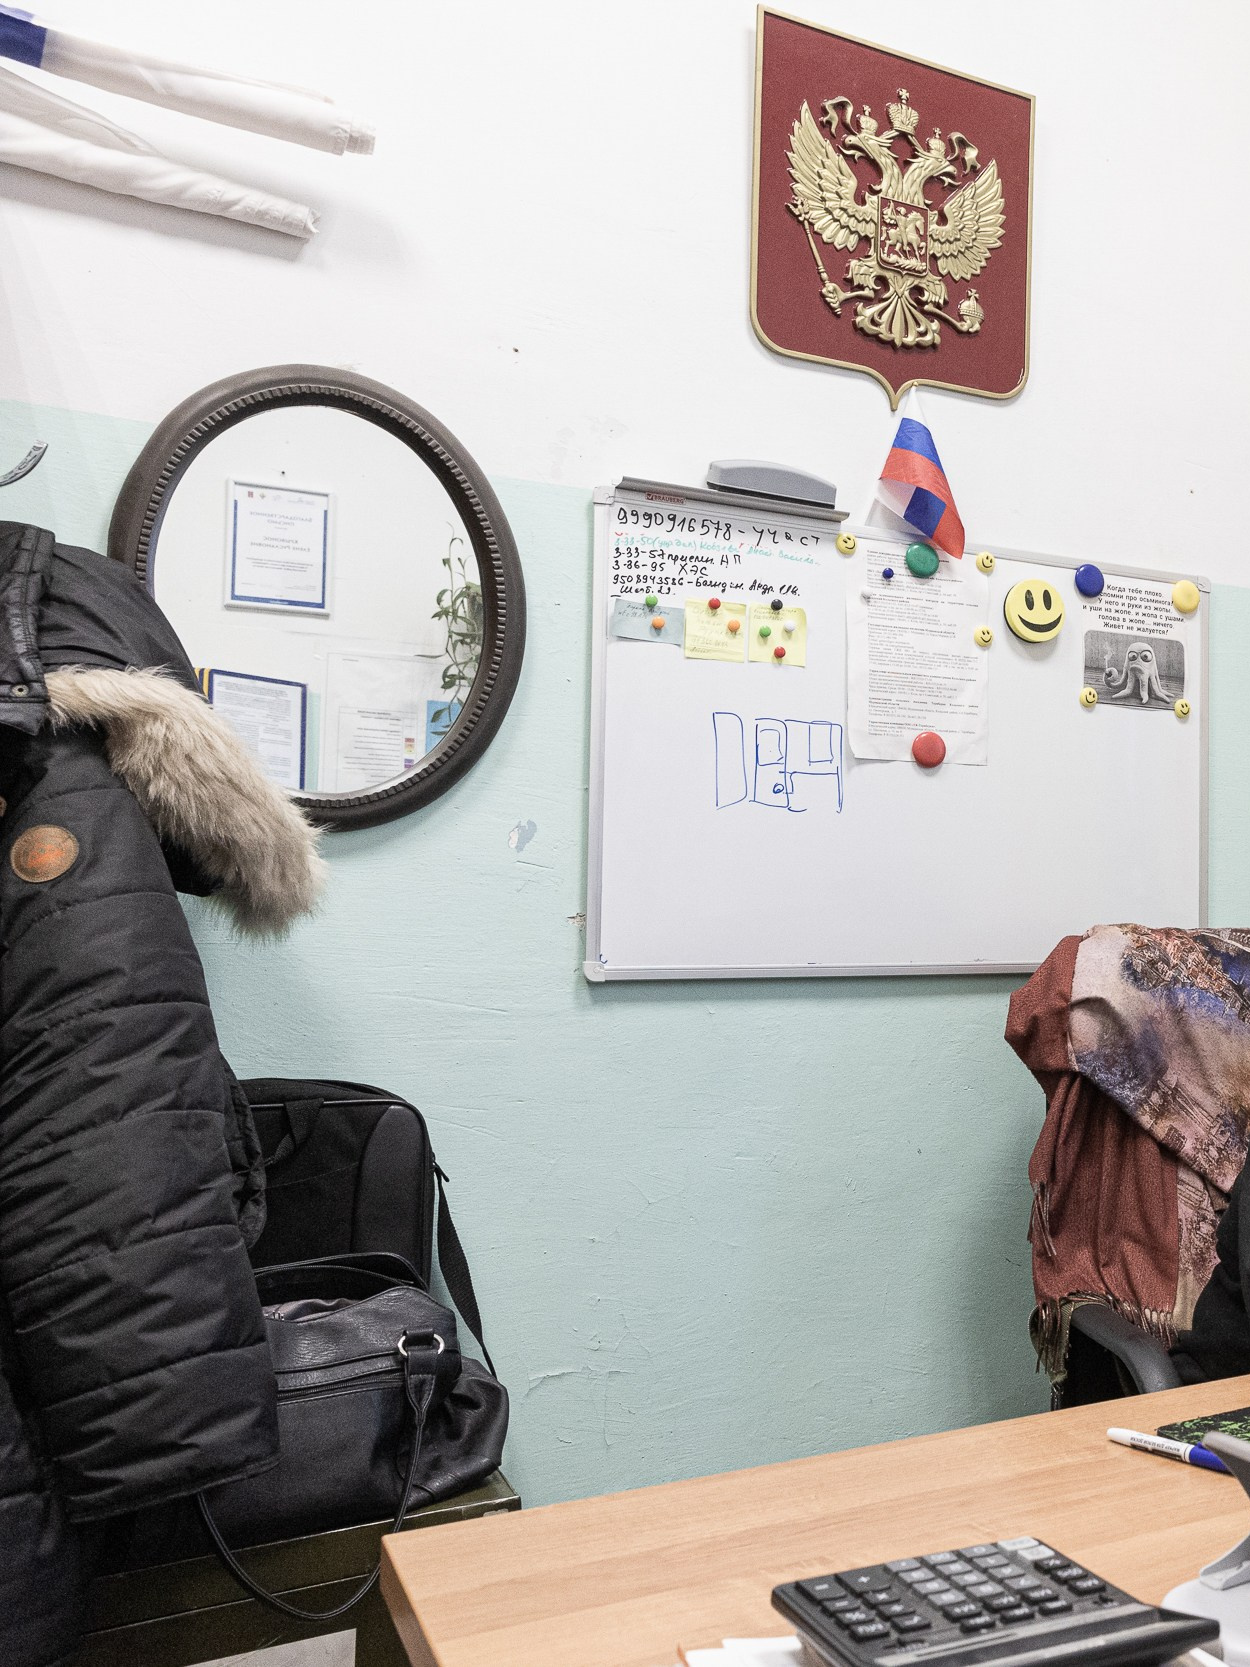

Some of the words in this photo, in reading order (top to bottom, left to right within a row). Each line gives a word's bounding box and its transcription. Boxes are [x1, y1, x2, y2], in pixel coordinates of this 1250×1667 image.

[1107, 584, 1125, 593] Когда
[1099, 591, 1123, 599] спомни
[1140, 597, 1173, 606] осьминога!
[1128, 602, 1142, 610] руки
[1103, 621, 1124, 629] Живет
[1137, 626, 1168, 635] жалуется!
